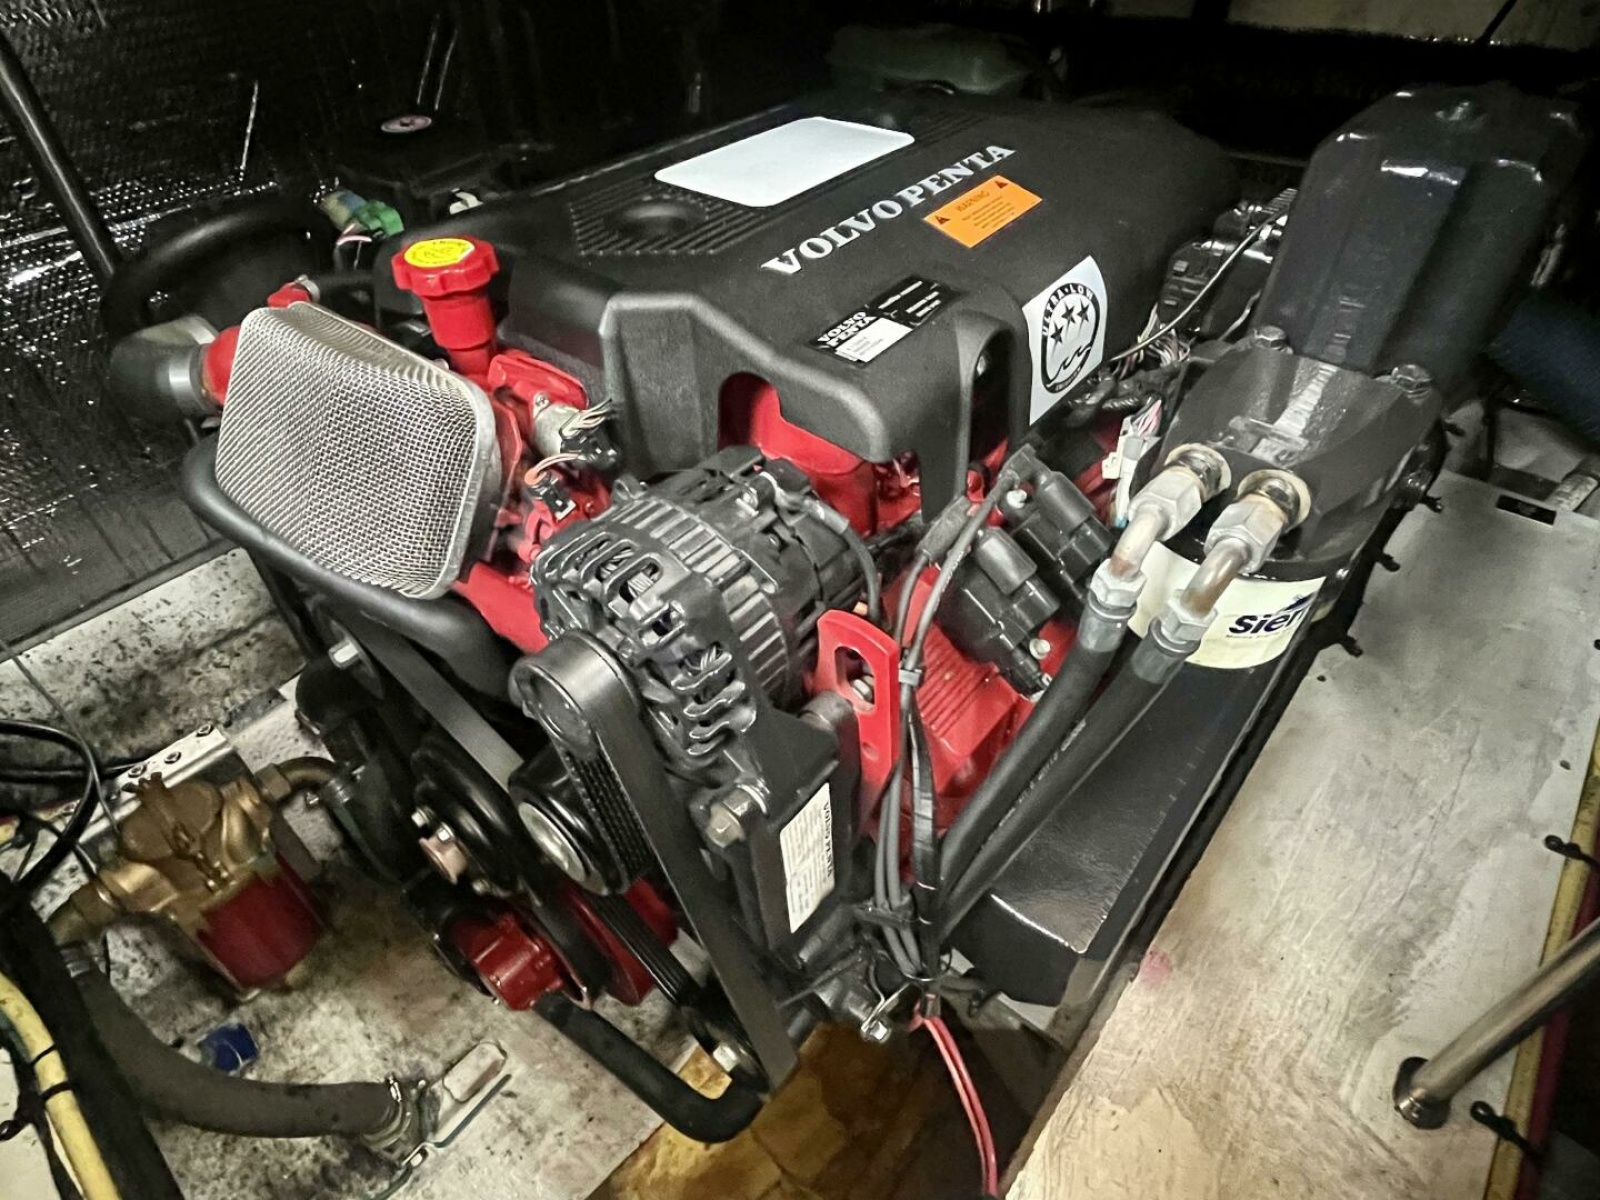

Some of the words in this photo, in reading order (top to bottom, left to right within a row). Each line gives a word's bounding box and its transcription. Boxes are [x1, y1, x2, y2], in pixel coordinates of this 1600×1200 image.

[761, 200, 903, 275] VOLVO
[895, 145, 1016, 207] PENTA
[817, 311, 867, 342] VOLVO
[826, 316, 878, 347] PENTA
[822, 801, 832, 840] VOLVO
[825, 840, 835, 878] PENTA
